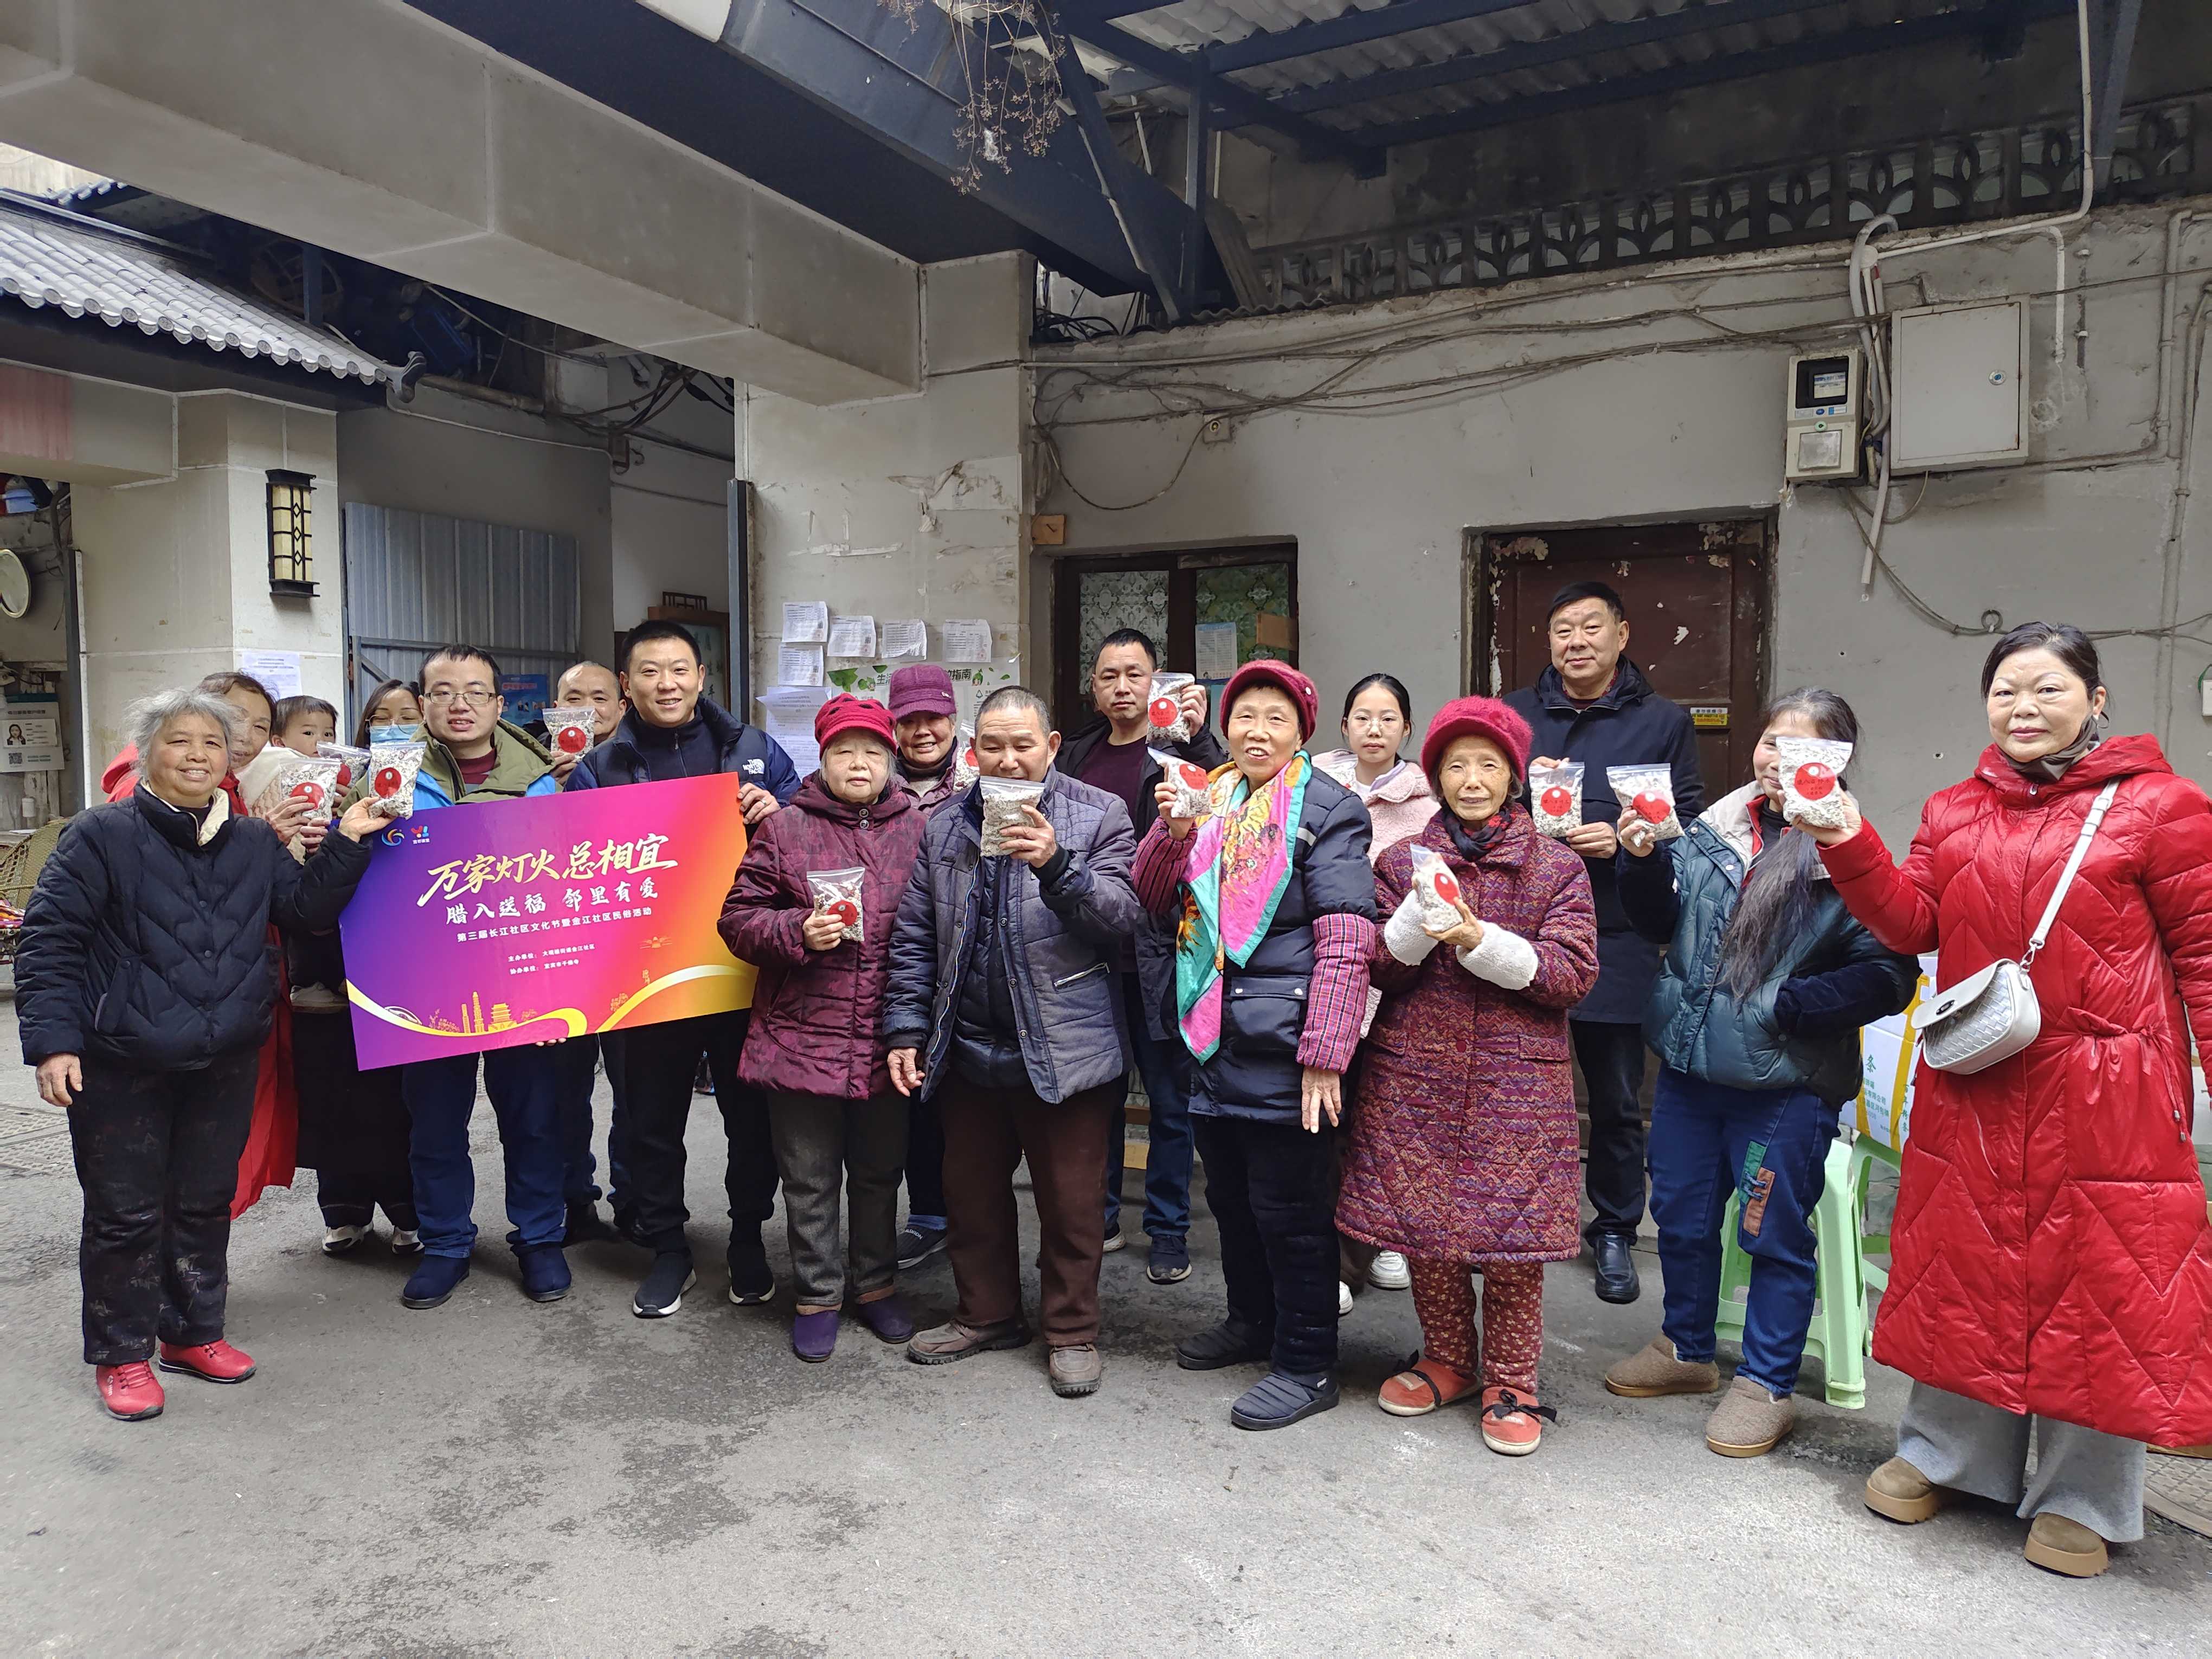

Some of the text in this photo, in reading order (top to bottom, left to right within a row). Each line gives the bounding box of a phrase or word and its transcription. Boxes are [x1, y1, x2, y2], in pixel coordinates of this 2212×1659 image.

[416, 833, 678, 907] 万家灯火总相宜
[446, 877, 658, 924] 腊八送福 邻里有爱
[457, 906, 652, 942] 第三届长江社区文化节暨金江社区民俗活动
